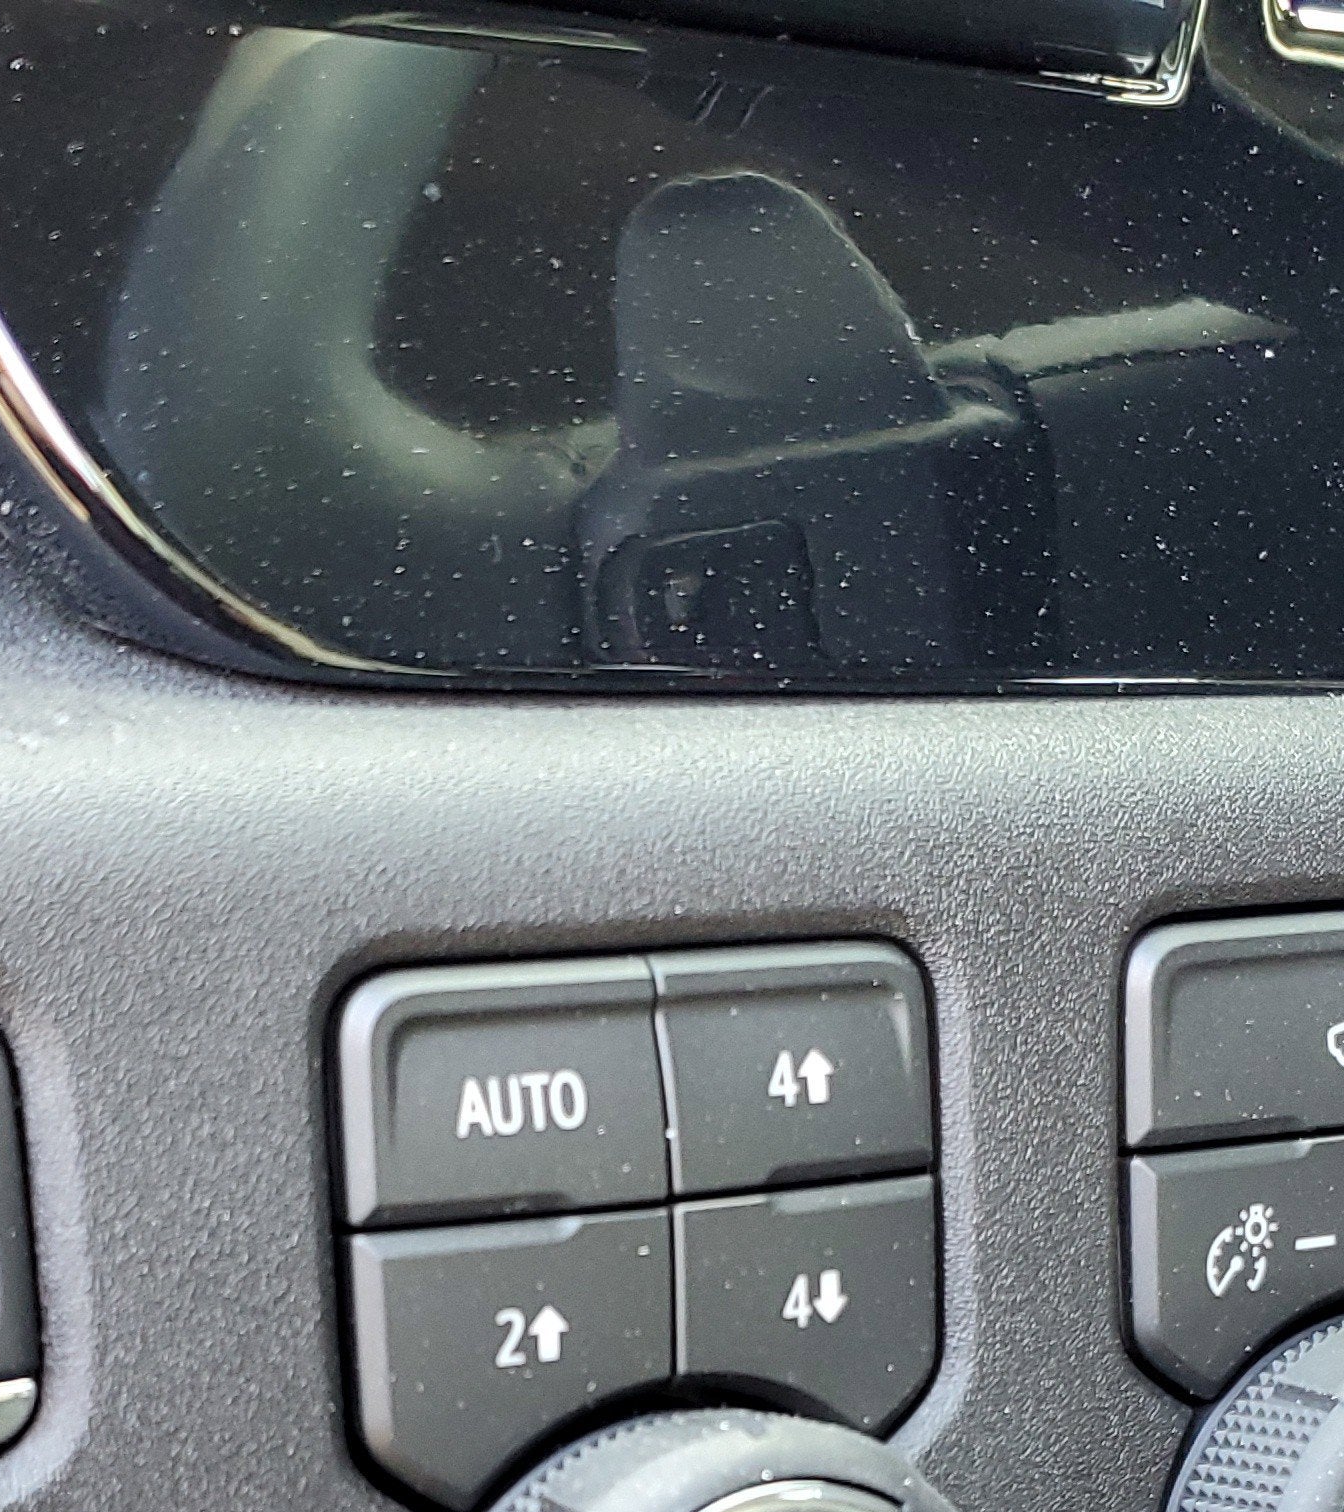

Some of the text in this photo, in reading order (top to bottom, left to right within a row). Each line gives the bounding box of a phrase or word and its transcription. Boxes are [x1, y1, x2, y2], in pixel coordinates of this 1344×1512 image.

[455, 1069, 589, 1139] AUTO
[767, 1050, 797, 1108] 4
[782, 1274, 812, 1328] 4
[494, 1307, 527, 1368] 2
